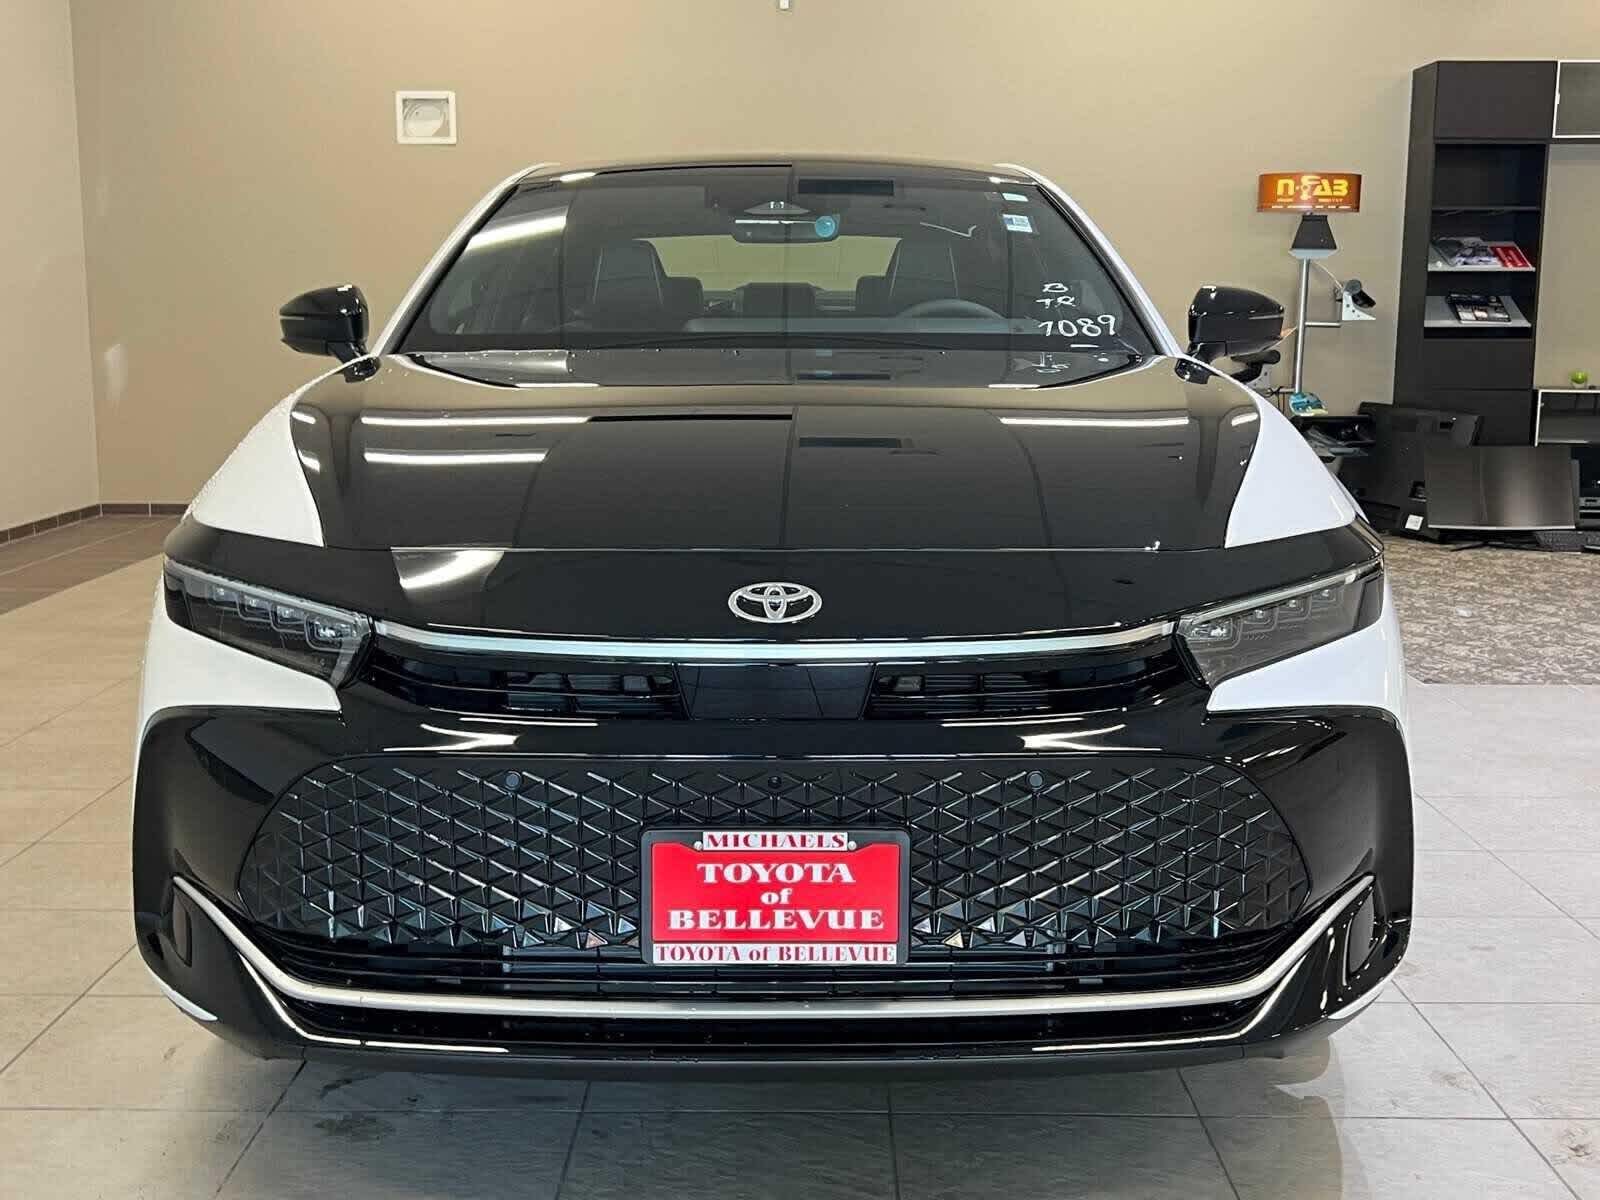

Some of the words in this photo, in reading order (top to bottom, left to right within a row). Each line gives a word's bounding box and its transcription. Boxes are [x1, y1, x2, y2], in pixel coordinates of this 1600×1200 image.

[706, 833, 846, 849] MICHAELS
[696, 863, 856, 884] TOYOTA
[760, 888, 793, 905] of
[668, 909, 885, 930] BELLEVUE
[655, 945, 741, 962] TOYOTA
[749, 945, 769, 962] of
[778, 945, 896, 962] BELLEVUE
